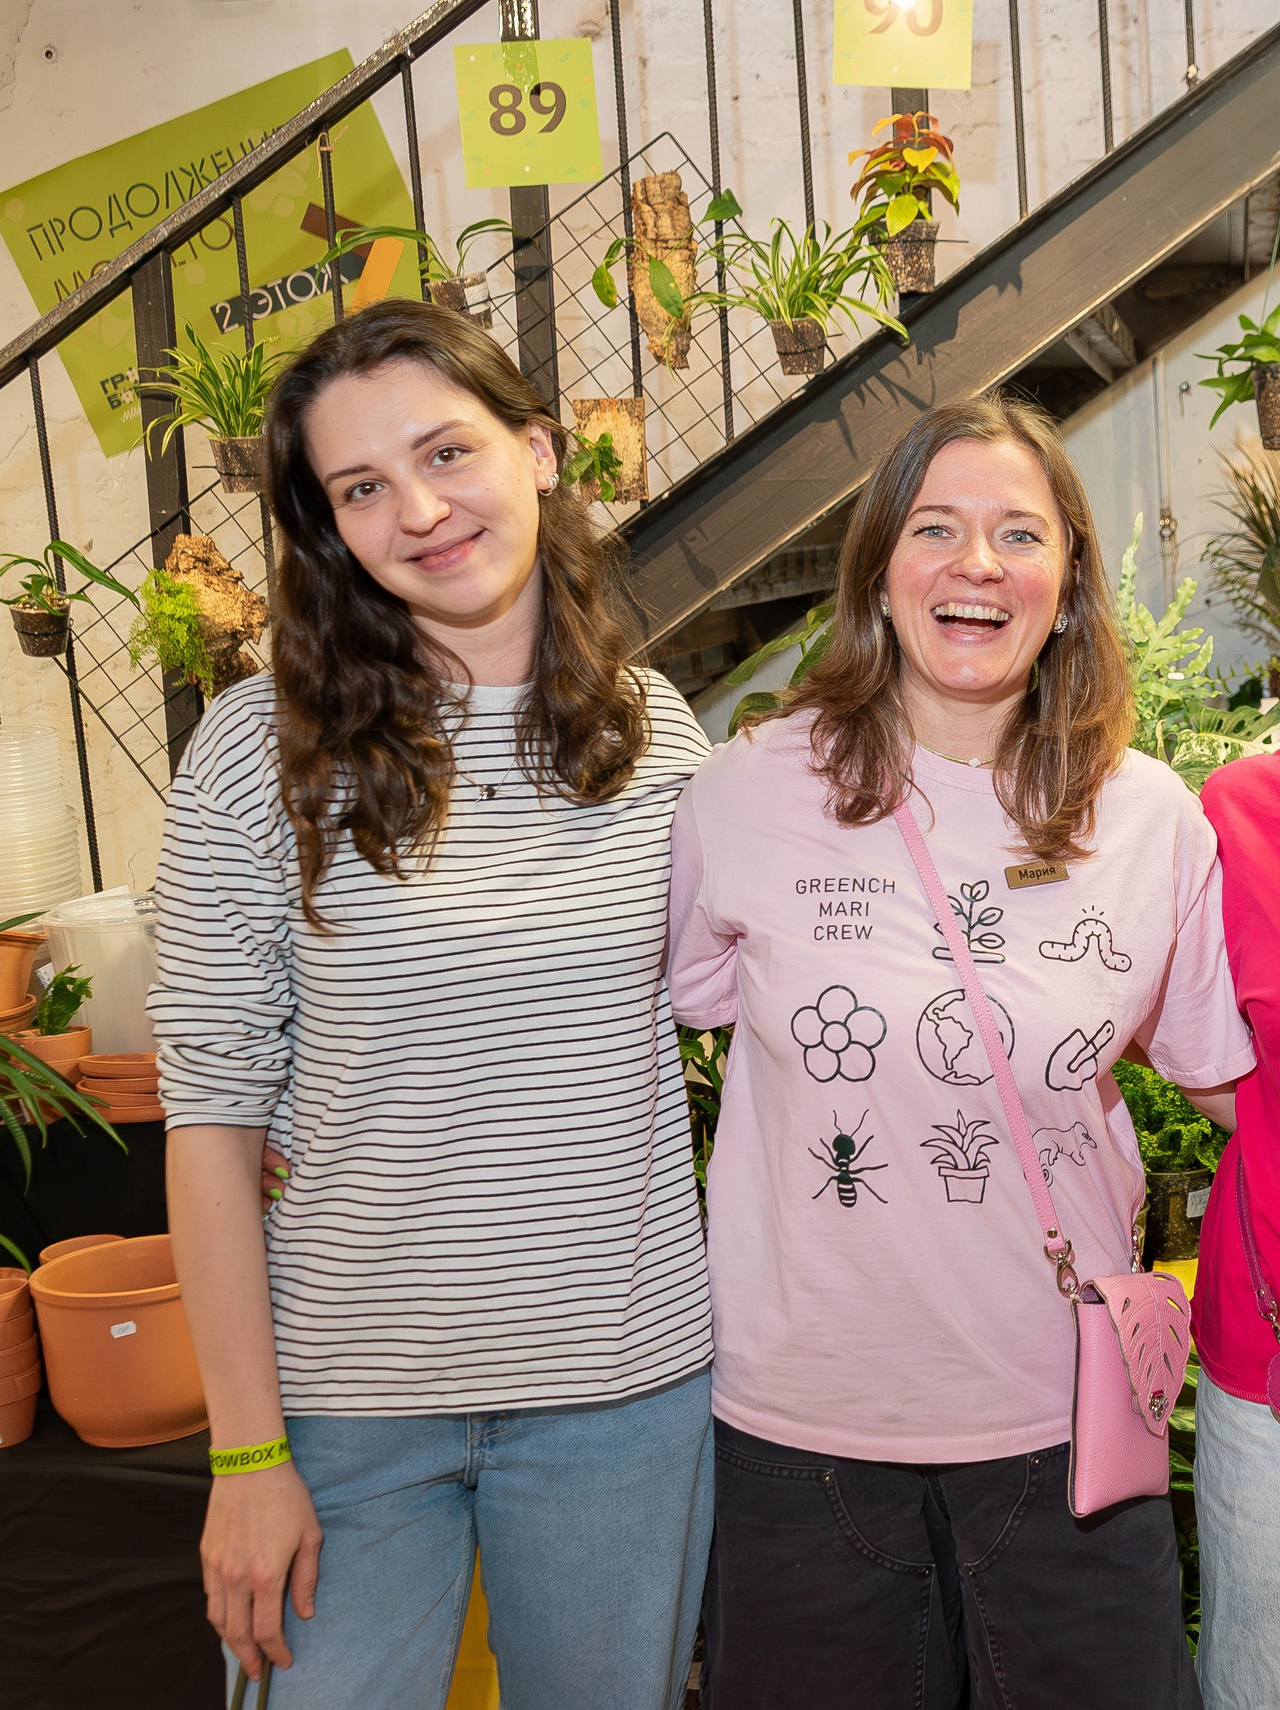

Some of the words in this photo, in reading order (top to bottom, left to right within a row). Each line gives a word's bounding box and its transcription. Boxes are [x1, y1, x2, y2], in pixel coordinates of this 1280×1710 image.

[863, 0, 944, 36] 90
[487, 81, 567, 137] 89
[215, 300, 240, 334] 2
[1018, 866, 1057, 881] Мария
[795, 877, 896, 895] GREENCH
[818, 901, 870, 918] MARI
[813, 924, 874, 941] CREW
[208, 1444, 277, 1469] ROWBOX
